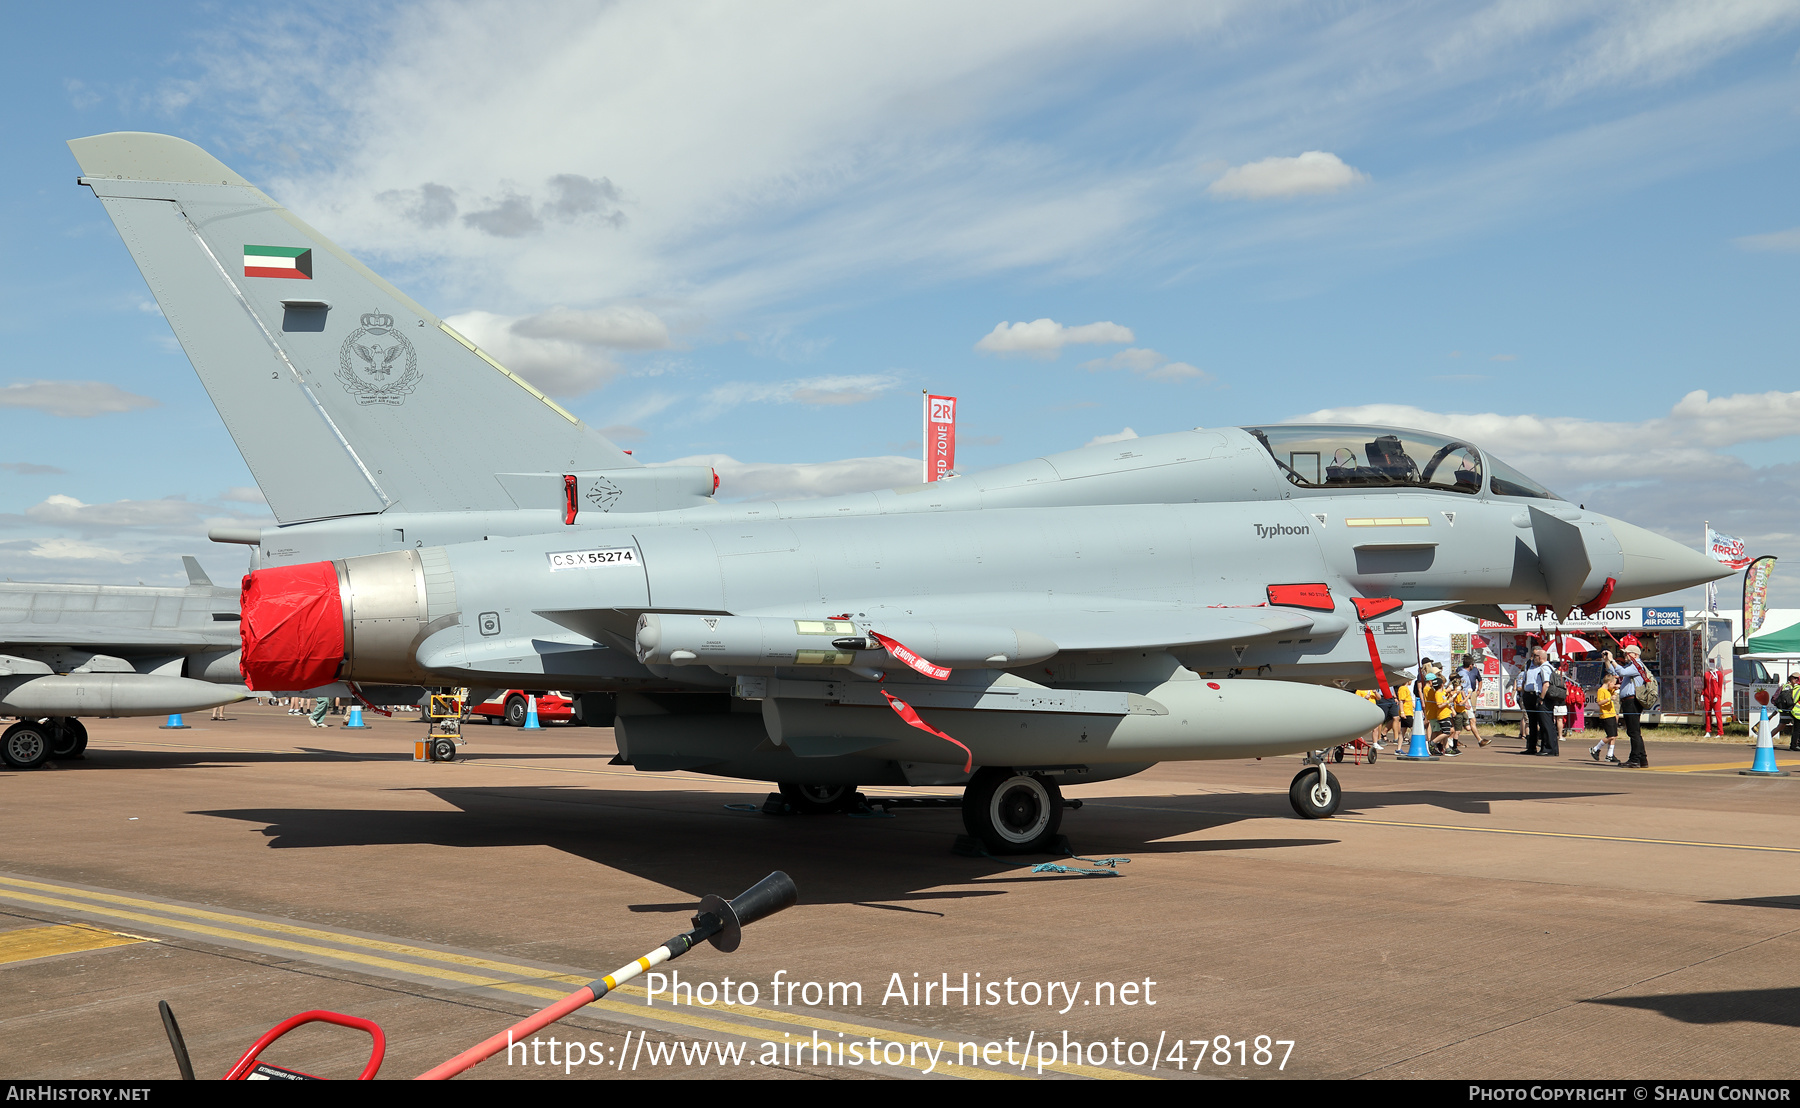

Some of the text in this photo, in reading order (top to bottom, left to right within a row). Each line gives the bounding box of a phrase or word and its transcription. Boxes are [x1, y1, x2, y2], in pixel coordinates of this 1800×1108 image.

[933, 404, 951, 419] 2R
[937, 425, 947, 456] ZONE
[1253, 523, 1310, 539] Typhoon
[588, 551, 633, 564] 55274
[1751, 563, 1766, 629] FRESH FRUIT
[1526, 612, 1548, 621] RAF
[1551, 610, 1631, 621] CLLECTIONS
[893, 645, 950, 678] REMOVE BEFORE FLIGHT
[258, 1066, 288, 1079] EXTINGUISHER
